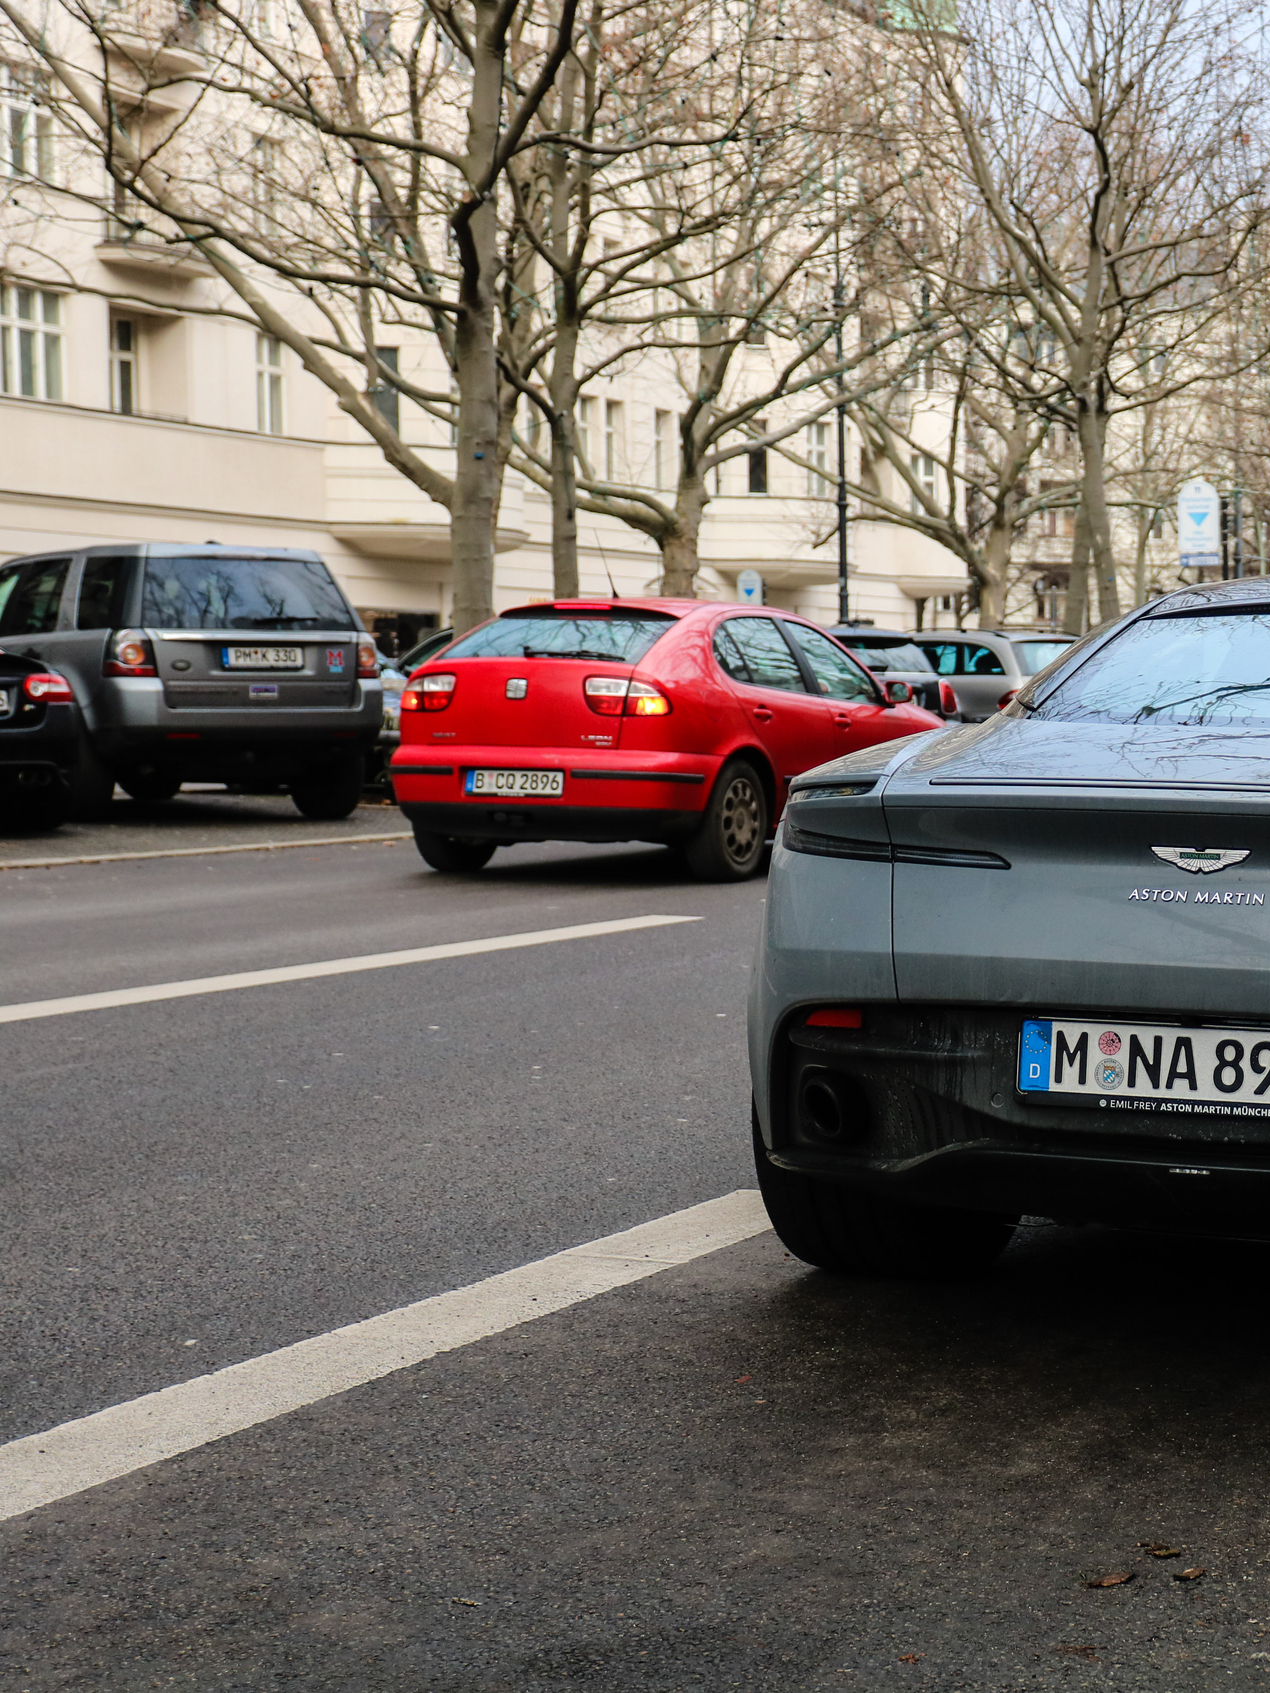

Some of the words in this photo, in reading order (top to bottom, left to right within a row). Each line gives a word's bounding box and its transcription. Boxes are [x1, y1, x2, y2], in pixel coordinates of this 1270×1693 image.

[235, 650, 251, 662] PM
[261, 651, 270, 662] K
[273, 649, 297, 662] 330
[475, 773, 484, 789] B
[495, 773, 516, 790] CQ
[520, 773, 560, 791] 2896
[1181, 852, 1199, 860] ASTON
[1200, 852, 1220, 860] MARTIN
[1128, 888, 1188, 903] ASTON
[1194, 891, 1265, 906] MARTIN
[1054, 1030, 1088, 1085] M
[1127, 1034, 1198, 1091] NA
[1110, 1099, 1132, 1109] EMIL
[1133, 1101, 1157, 1111] FREY
[1160, 1103, 1193, 1112] ASTON
[1194, 1106, 1231, 1115] MARTIN
